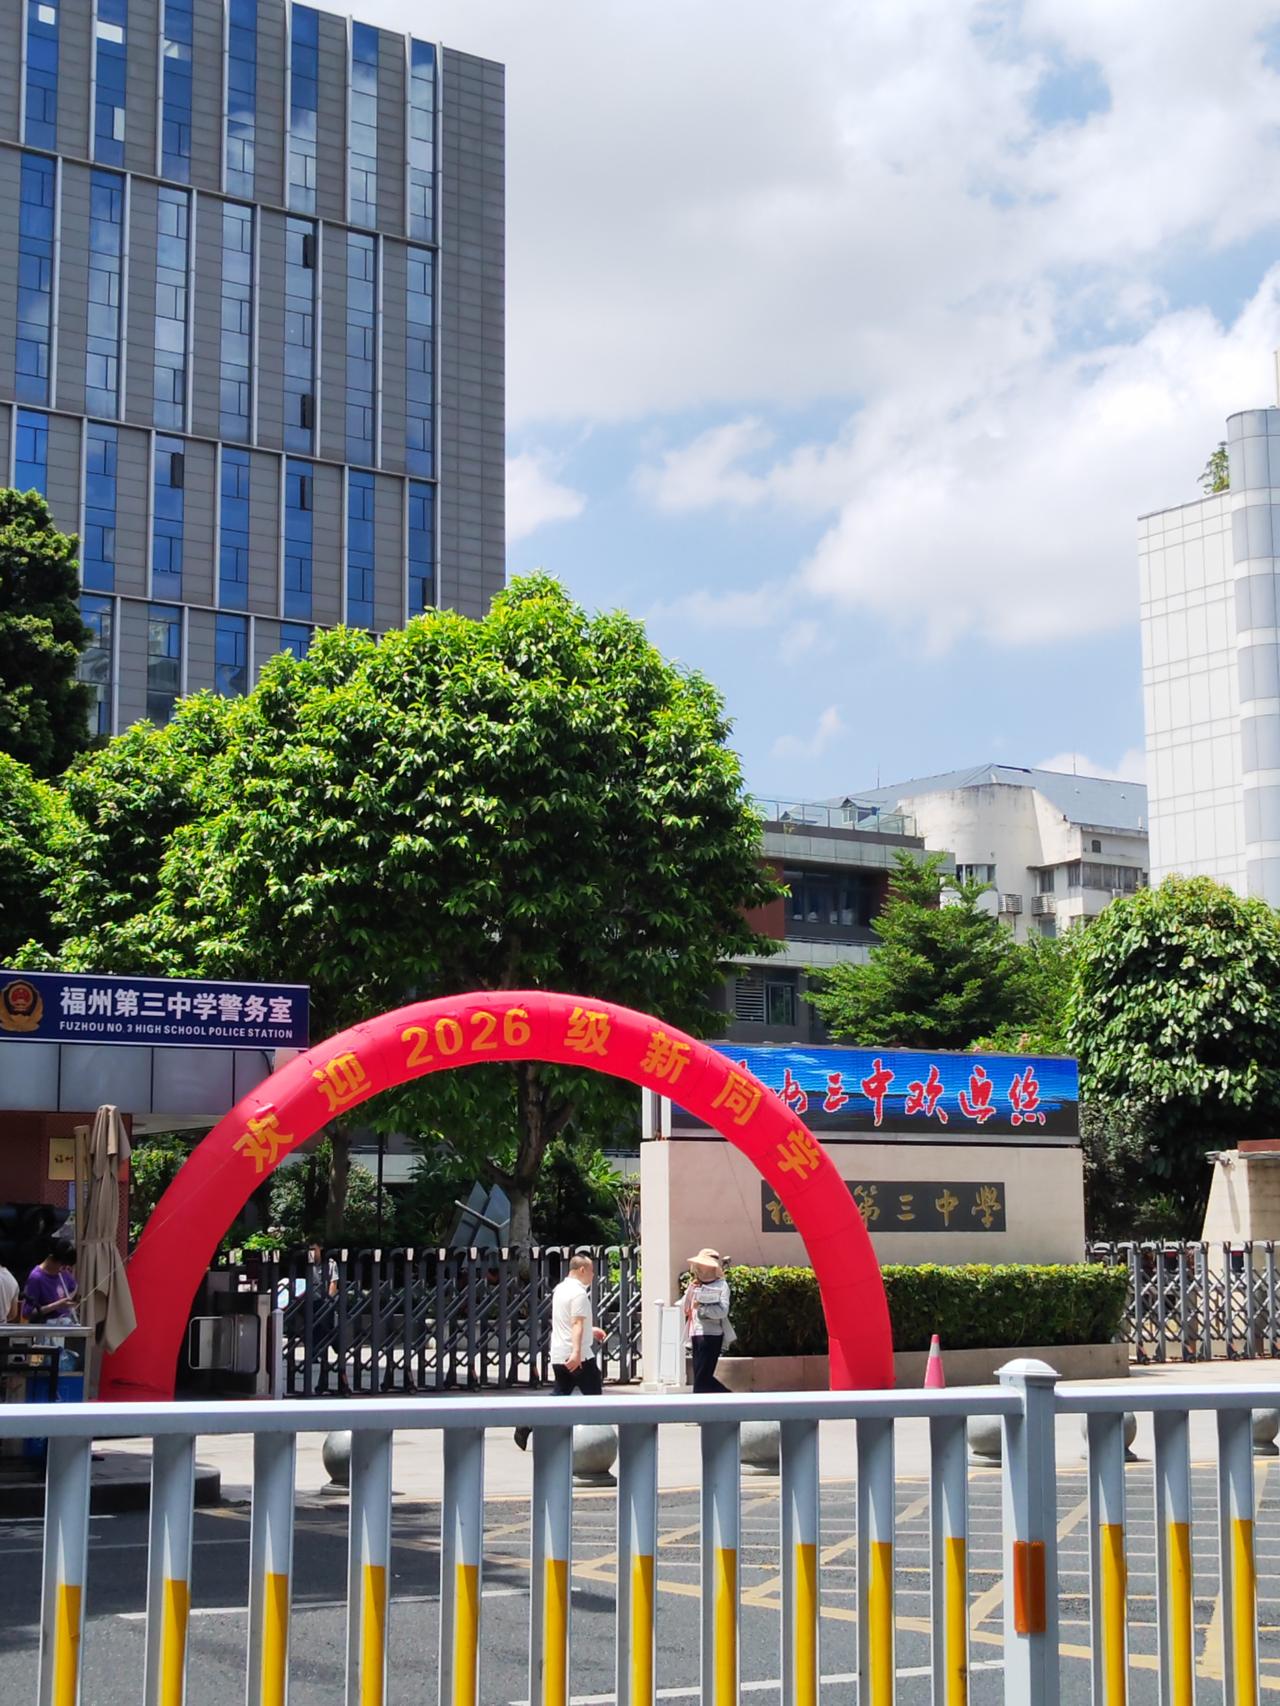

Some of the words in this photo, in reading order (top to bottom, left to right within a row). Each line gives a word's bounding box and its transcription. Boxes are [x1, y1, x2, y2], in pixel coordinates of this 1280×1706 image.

[60, 986, 293, 1023] 福州第三中学警务室
[60, 1021, 104, 1032] FUZHOU
[135, 1024, 161, 1034] HIGH
[163, 1025, 206, 1036] SCHOOL
[208, 1027, 246, 1037] POLICE
[247, 1028, 293, 1039] STATION
[738, 1058, 1046, 1127] 州三中欢迎您
